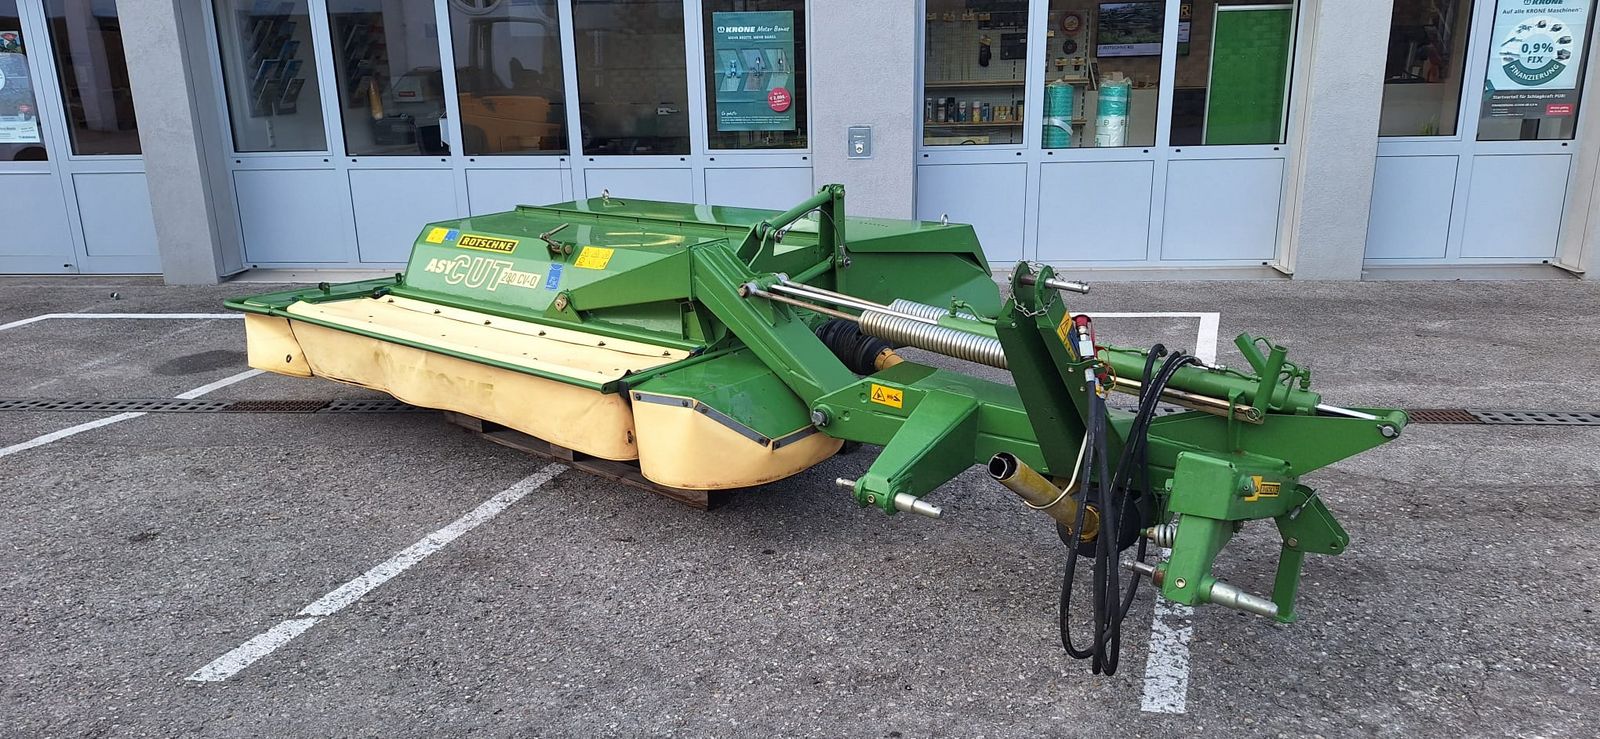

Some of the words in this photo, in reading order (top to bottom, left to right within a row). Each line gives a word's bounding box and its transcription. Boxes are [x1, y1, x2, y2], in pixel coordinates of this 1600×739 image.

[1520, 42, 1554, 54] 0,9%
[1526, 55, 1544, 64] FIX
[1509, 63, 1560, 81] FINANZIERUNG
[461, 237, 513, 251] ROTSCHNE
[501, 271, 517, 284] 280
